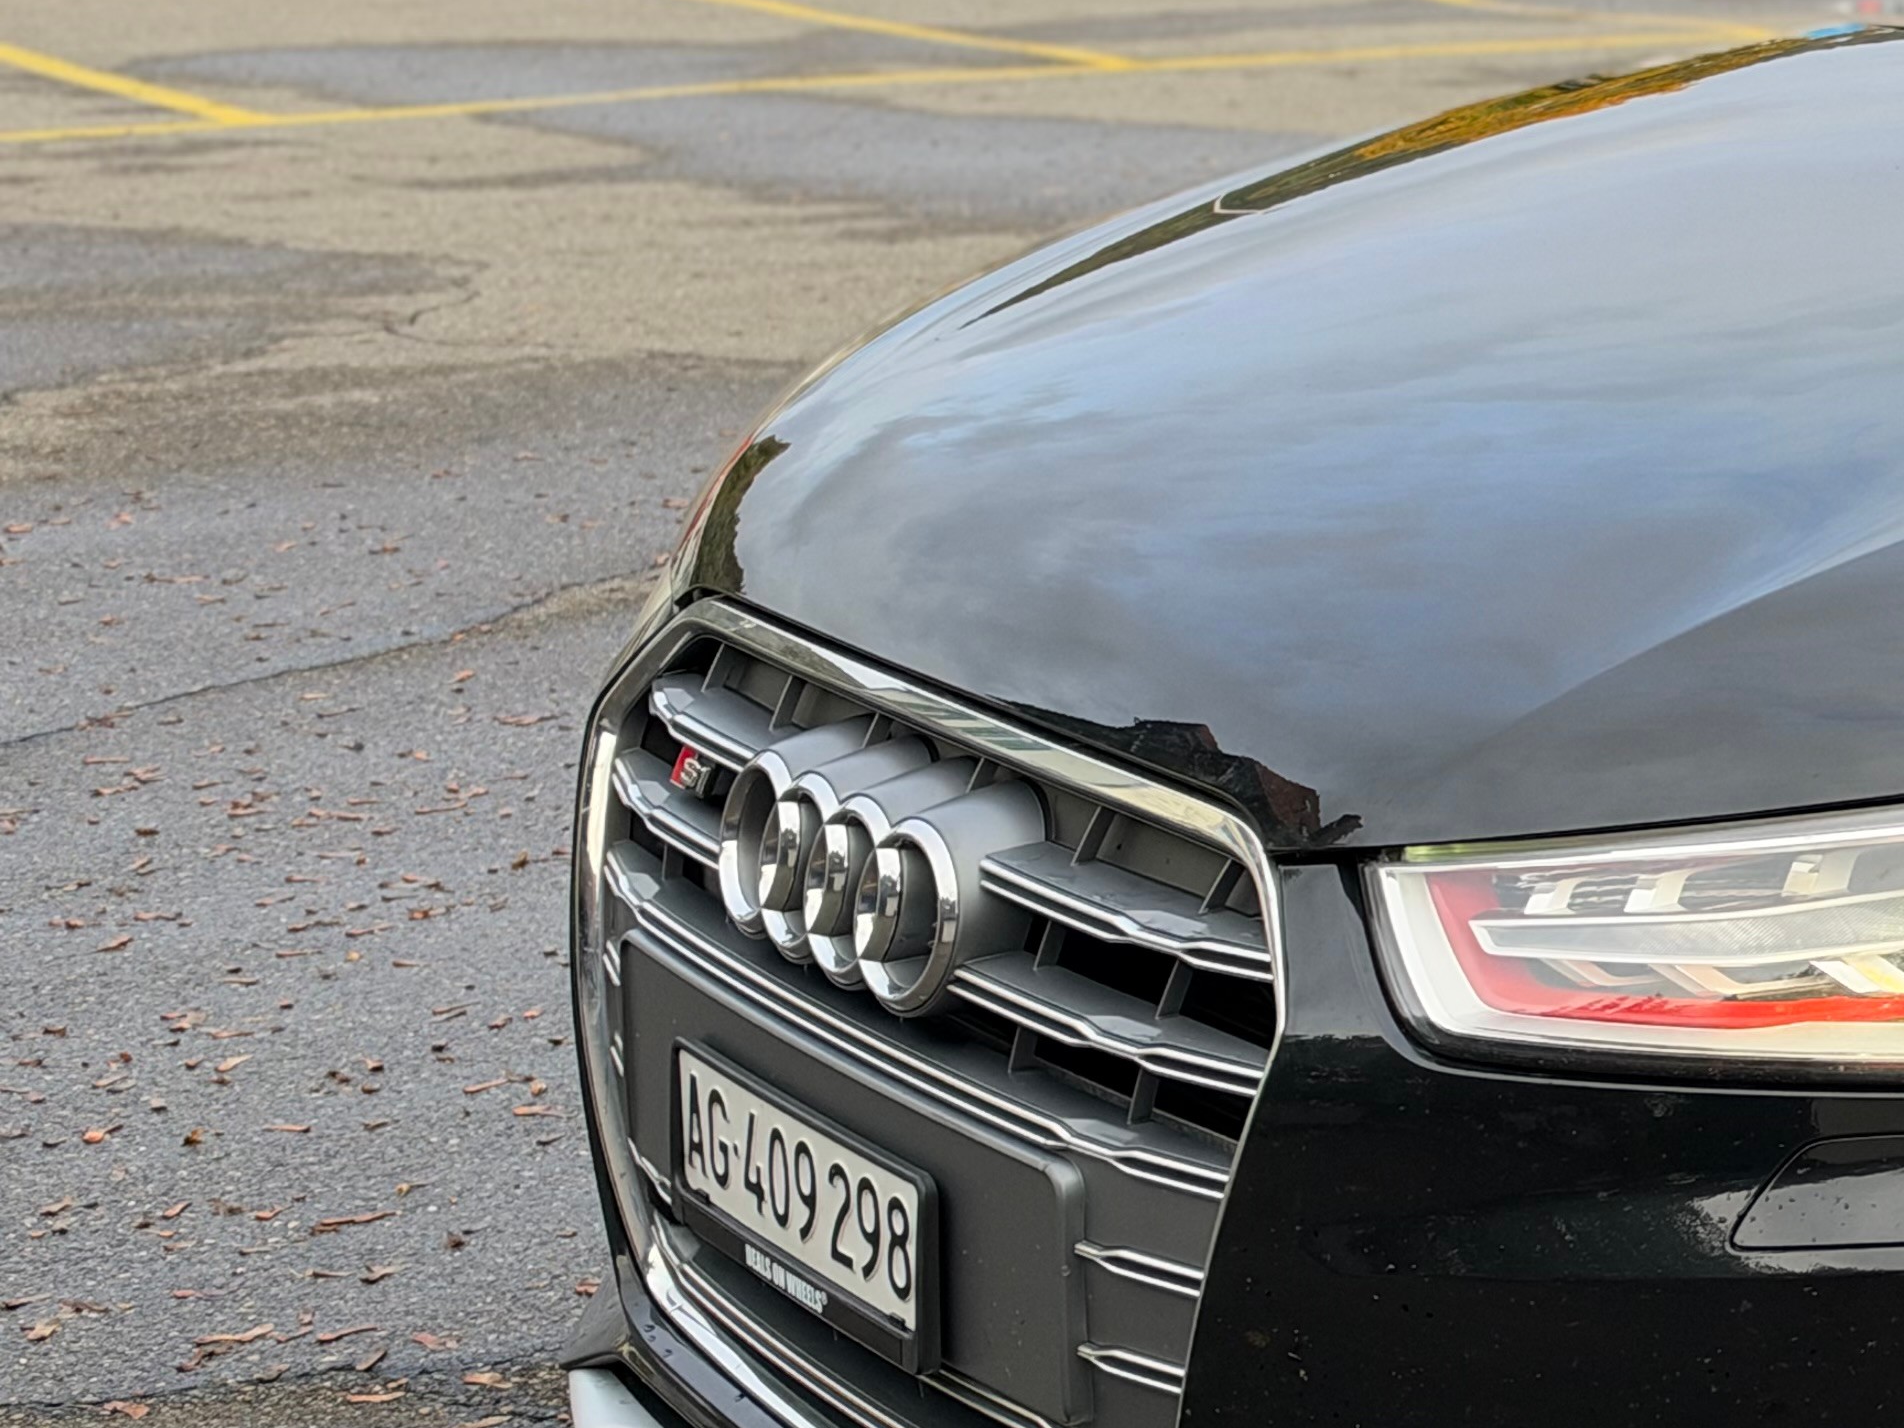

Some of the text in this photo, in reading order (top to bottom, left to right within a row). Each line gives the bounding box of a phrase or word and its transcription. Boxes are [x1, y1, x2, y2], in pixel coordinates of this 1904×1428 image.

[680, 757, 712, 799] S1
[826, 1162, 913, 1302] 298
[744, 1243, 772, 1281] DEALS
[771, 1262, 786, 1290] ON
